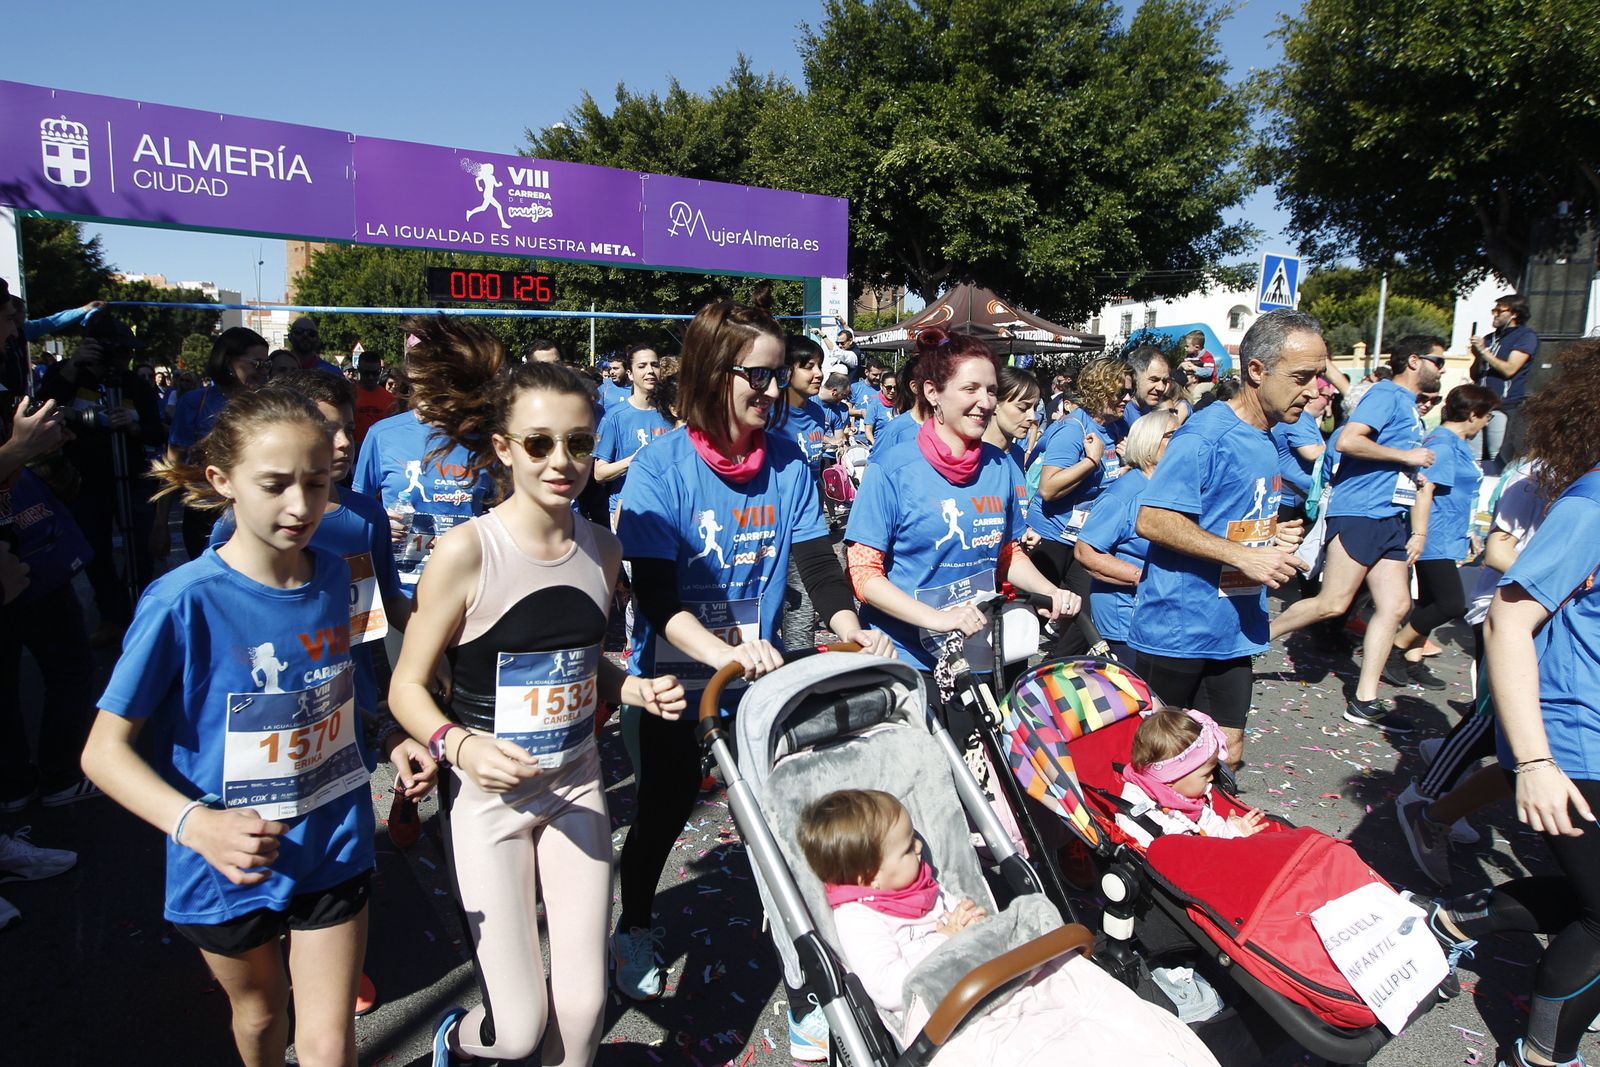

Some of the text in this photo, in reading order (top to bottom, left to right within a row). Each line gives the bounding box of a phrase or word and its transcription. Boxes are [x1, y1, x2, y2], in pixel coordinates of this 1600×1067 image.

[132, 134, 312, 184] ALMERÍA
[133, 169, 229, 198] CIUDAD
[507, 166, 550, 189] VIII
[507, 188, 551, 201] CARRERA
[366, 222, 637, 257] LA IGUALDAD ES NUESTRA META.
[732, 504, 775, 529] VIII
[970, 495, 1004, 515] VIII
[733, 530, 776, 543] CARRERA
[568, 650, 585, 661] VIII
[523, 679, 595, 717] 1532
[543, 711, 582, 726] CANDELA
[259, 710, 341, 764] 1570
[294, 753, 323, 771] ERIKA
[227, 796, 248, 807] NEXA
[1324, 912, 1384, 952] ESCUELA
[1346, 936, 1397, 982] INFANTIL
